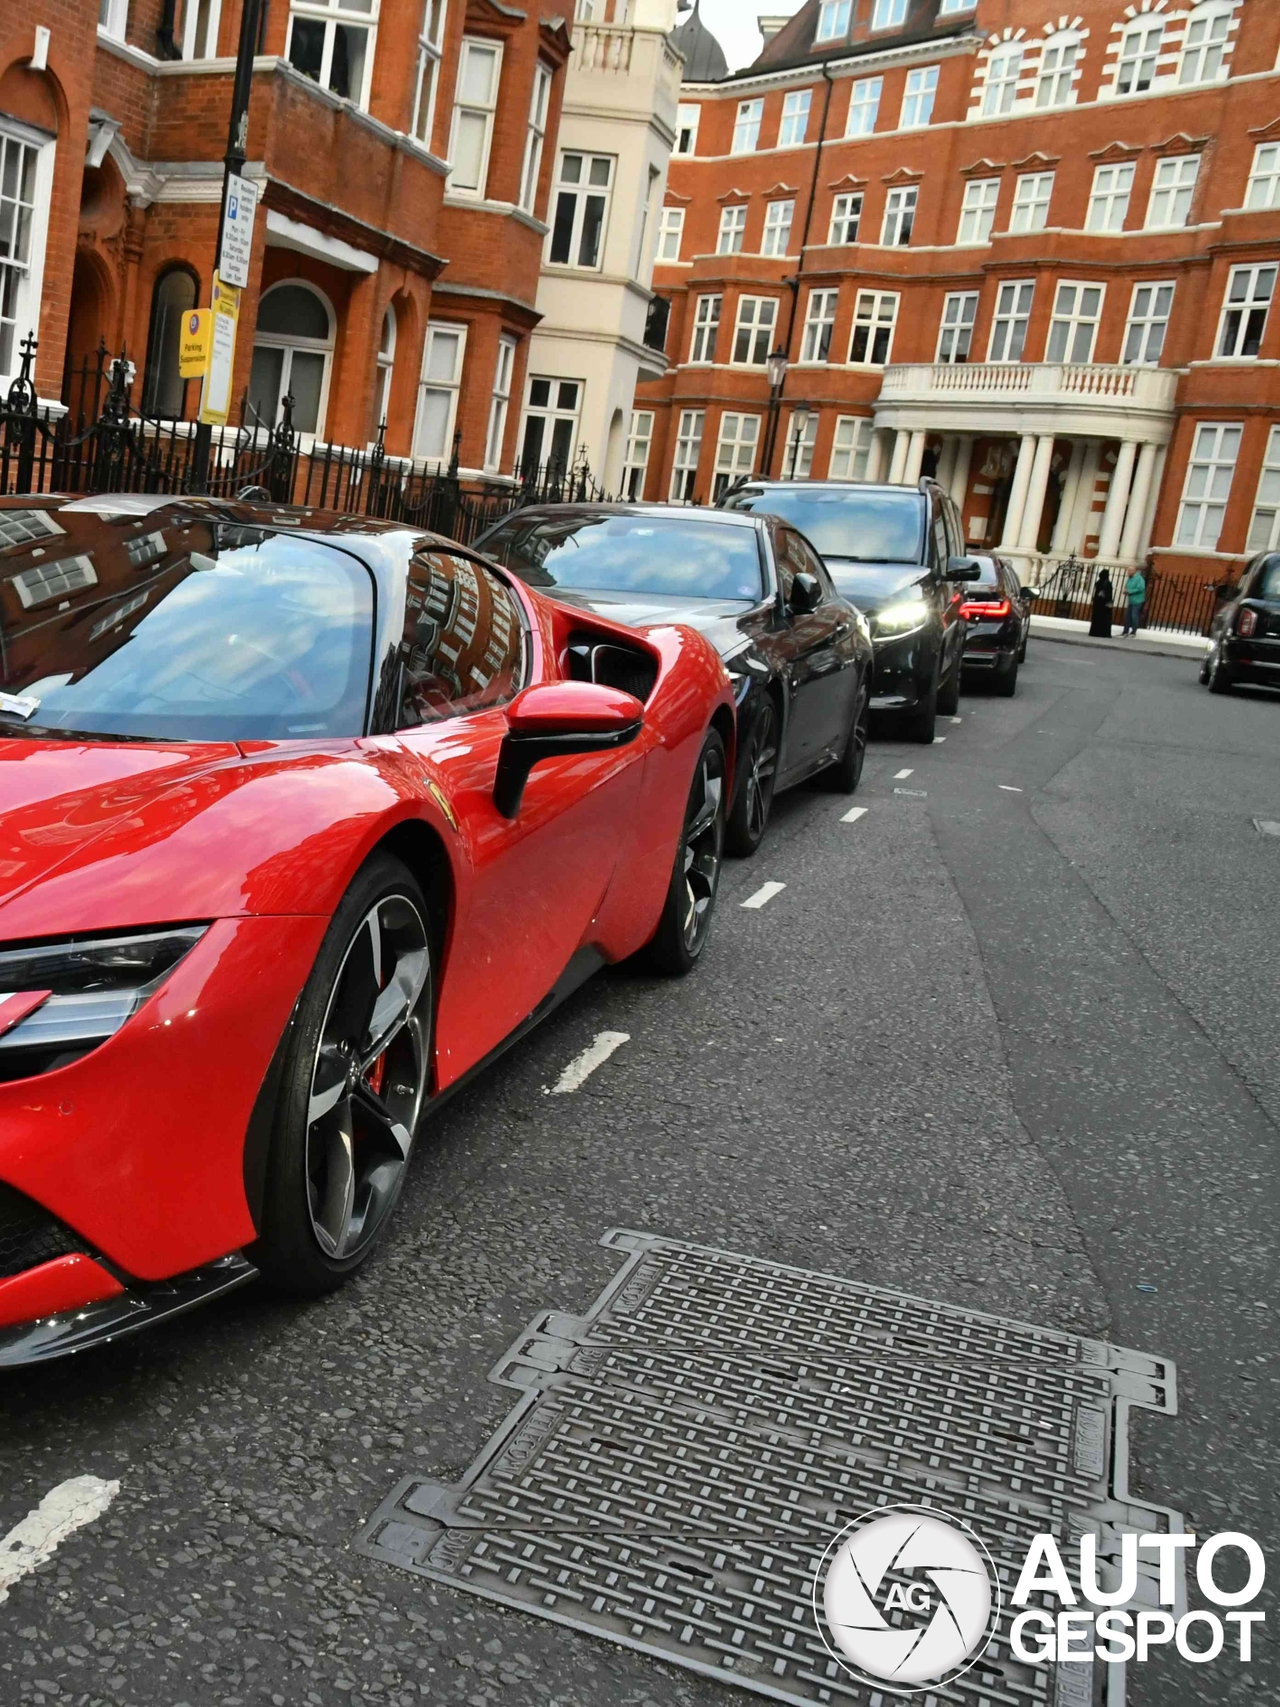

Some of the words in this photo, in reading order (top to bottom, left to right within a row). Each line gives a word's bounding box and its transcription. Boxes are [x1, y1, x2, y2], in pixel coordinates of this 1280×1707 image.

[180, 354, 206, 363] Suspension
[184, 343, 202, 353] Parking
[613, 1264, 660, 1312] TELECOM
[494, 1408, 560, 1472] TELECOM
[1076, 1410, 1103, 1471] TELECOM
